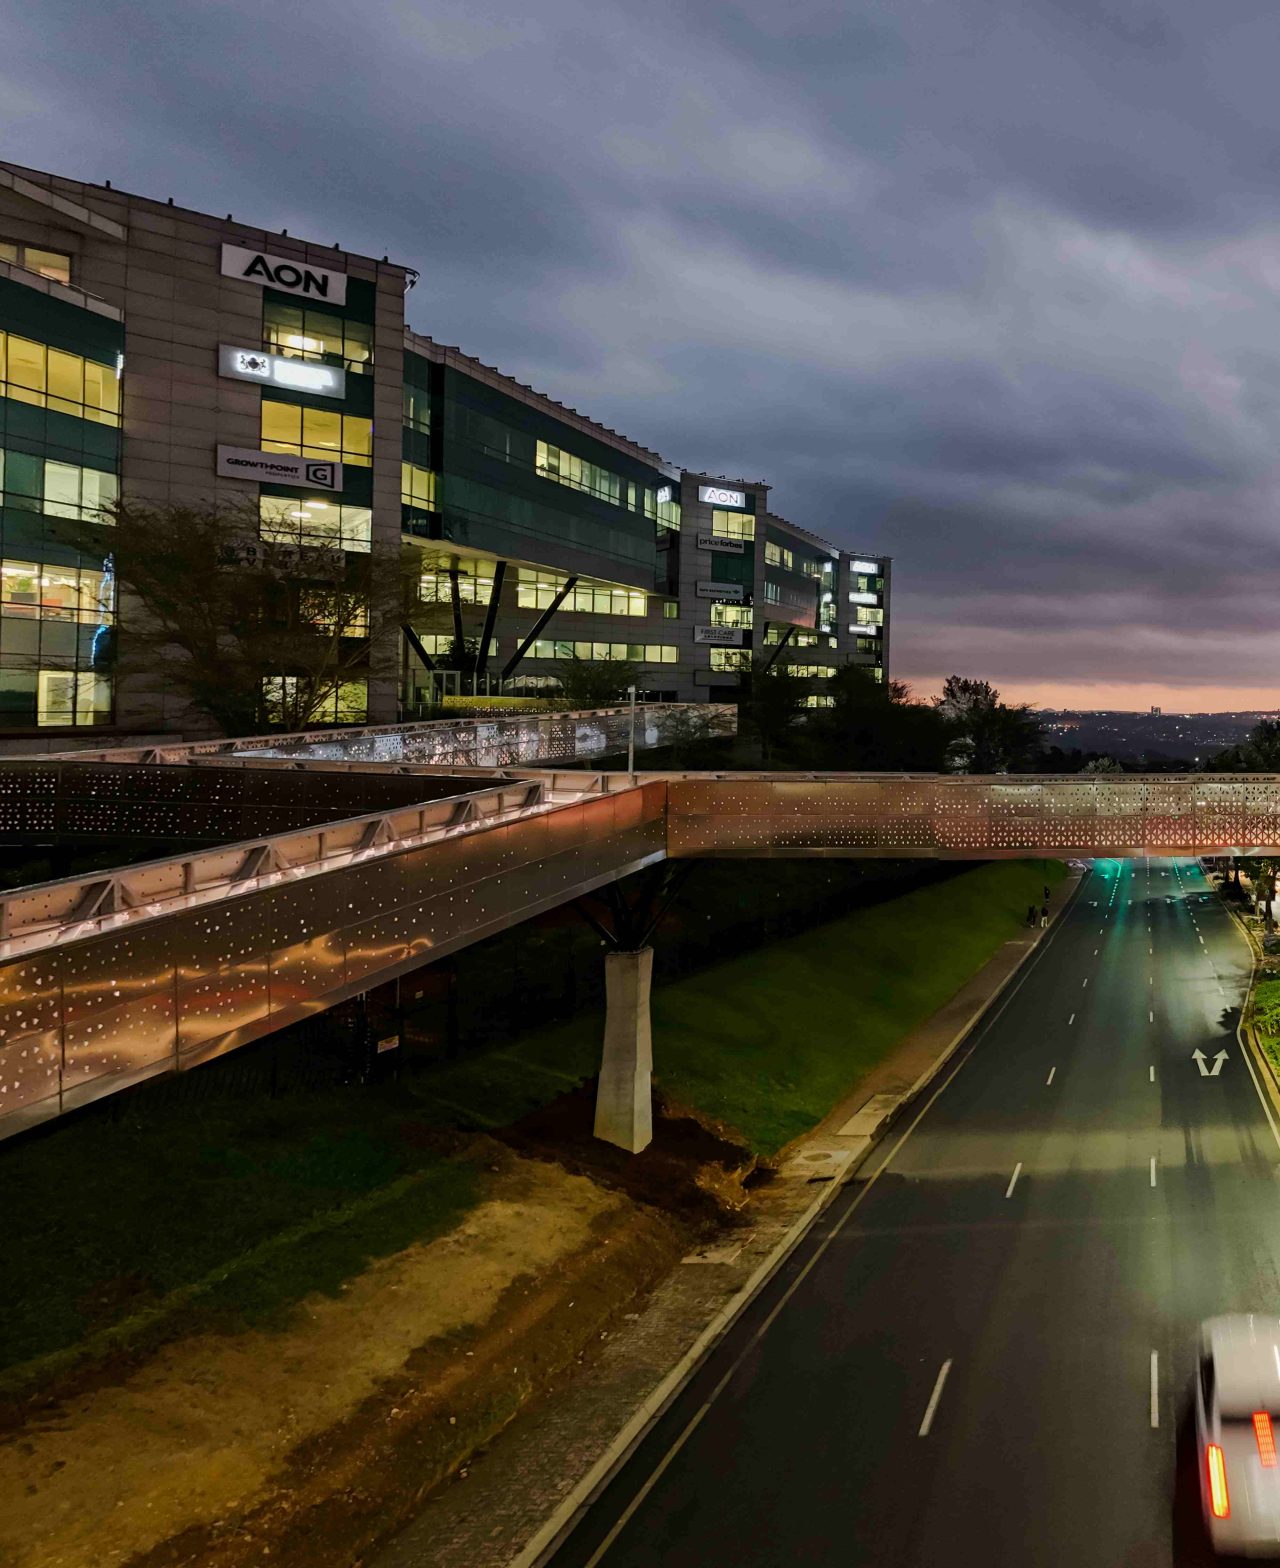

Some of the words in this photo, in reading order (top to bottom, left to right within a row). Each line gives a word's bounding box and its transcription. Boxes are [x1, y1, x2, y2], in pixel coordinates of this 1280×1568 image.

[243, 255, 329, 297] AON
[226, 457, 299, 473] GROWTHPOINT
[707, 489, 739, 505] AON
[700, 538, 719, 546] price
[720, 540, 743, 549] forbes
